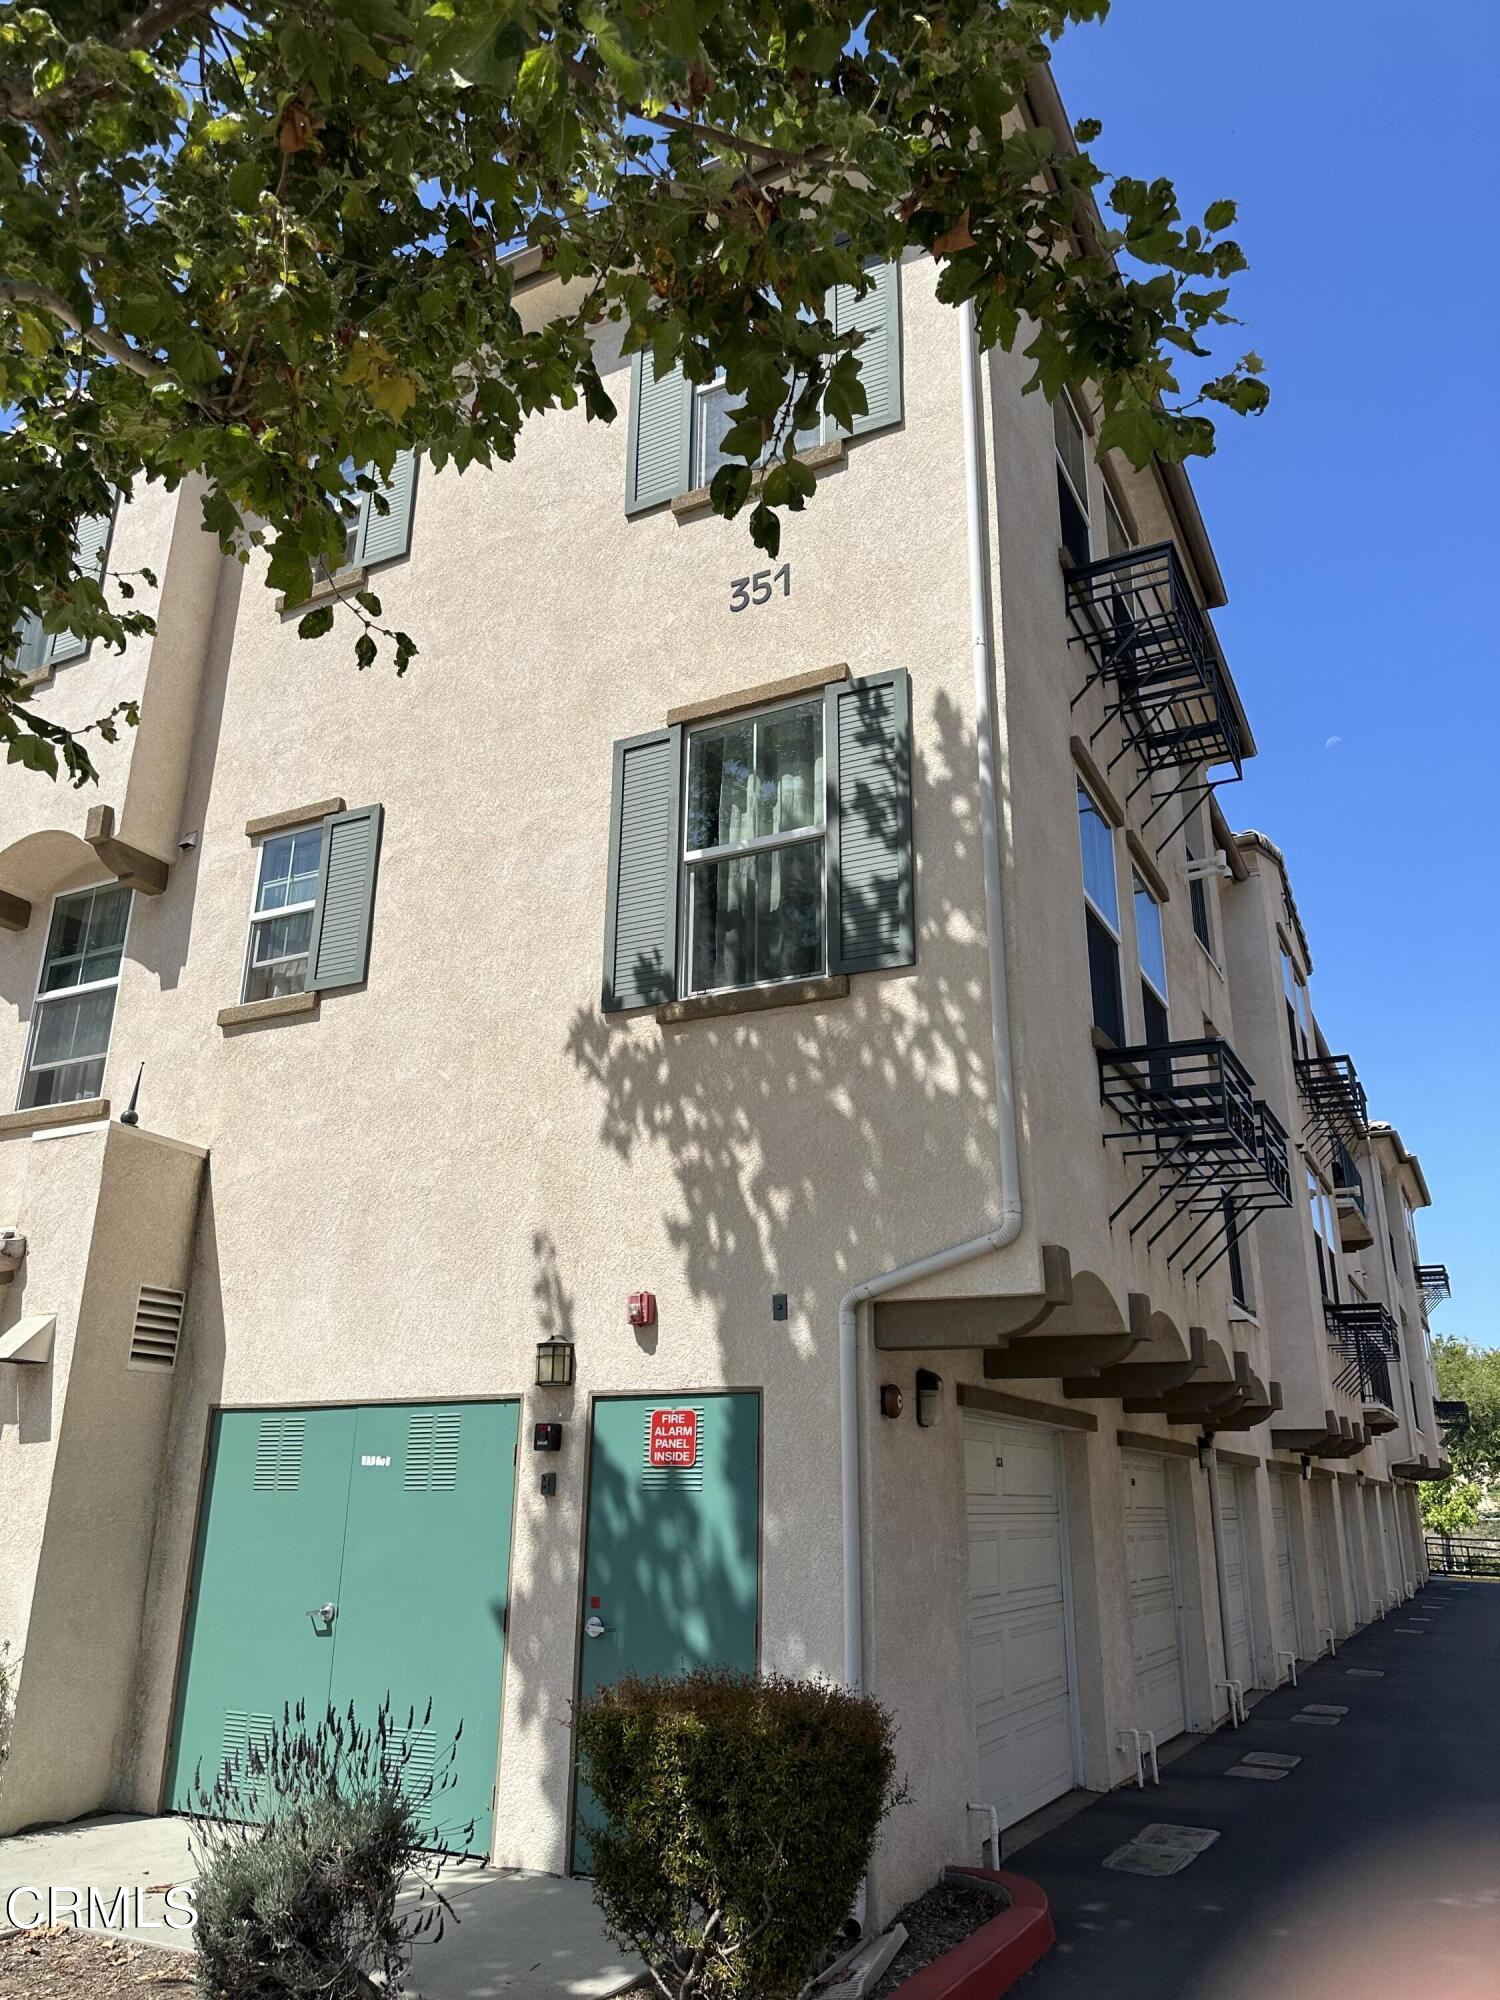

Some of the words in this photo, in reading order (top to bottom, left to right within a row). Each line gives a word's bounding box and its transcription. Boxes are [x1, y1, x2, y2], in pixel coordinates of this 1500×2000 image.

[729, 562, 791, 613] 351
[661, 1414, 686, 1424] FIRE
[654, 1426, 693, 1436] ALARM
[655, 1438, 690, 1449] PANEL
[653, 1451, 690, 1462] INSIDE
